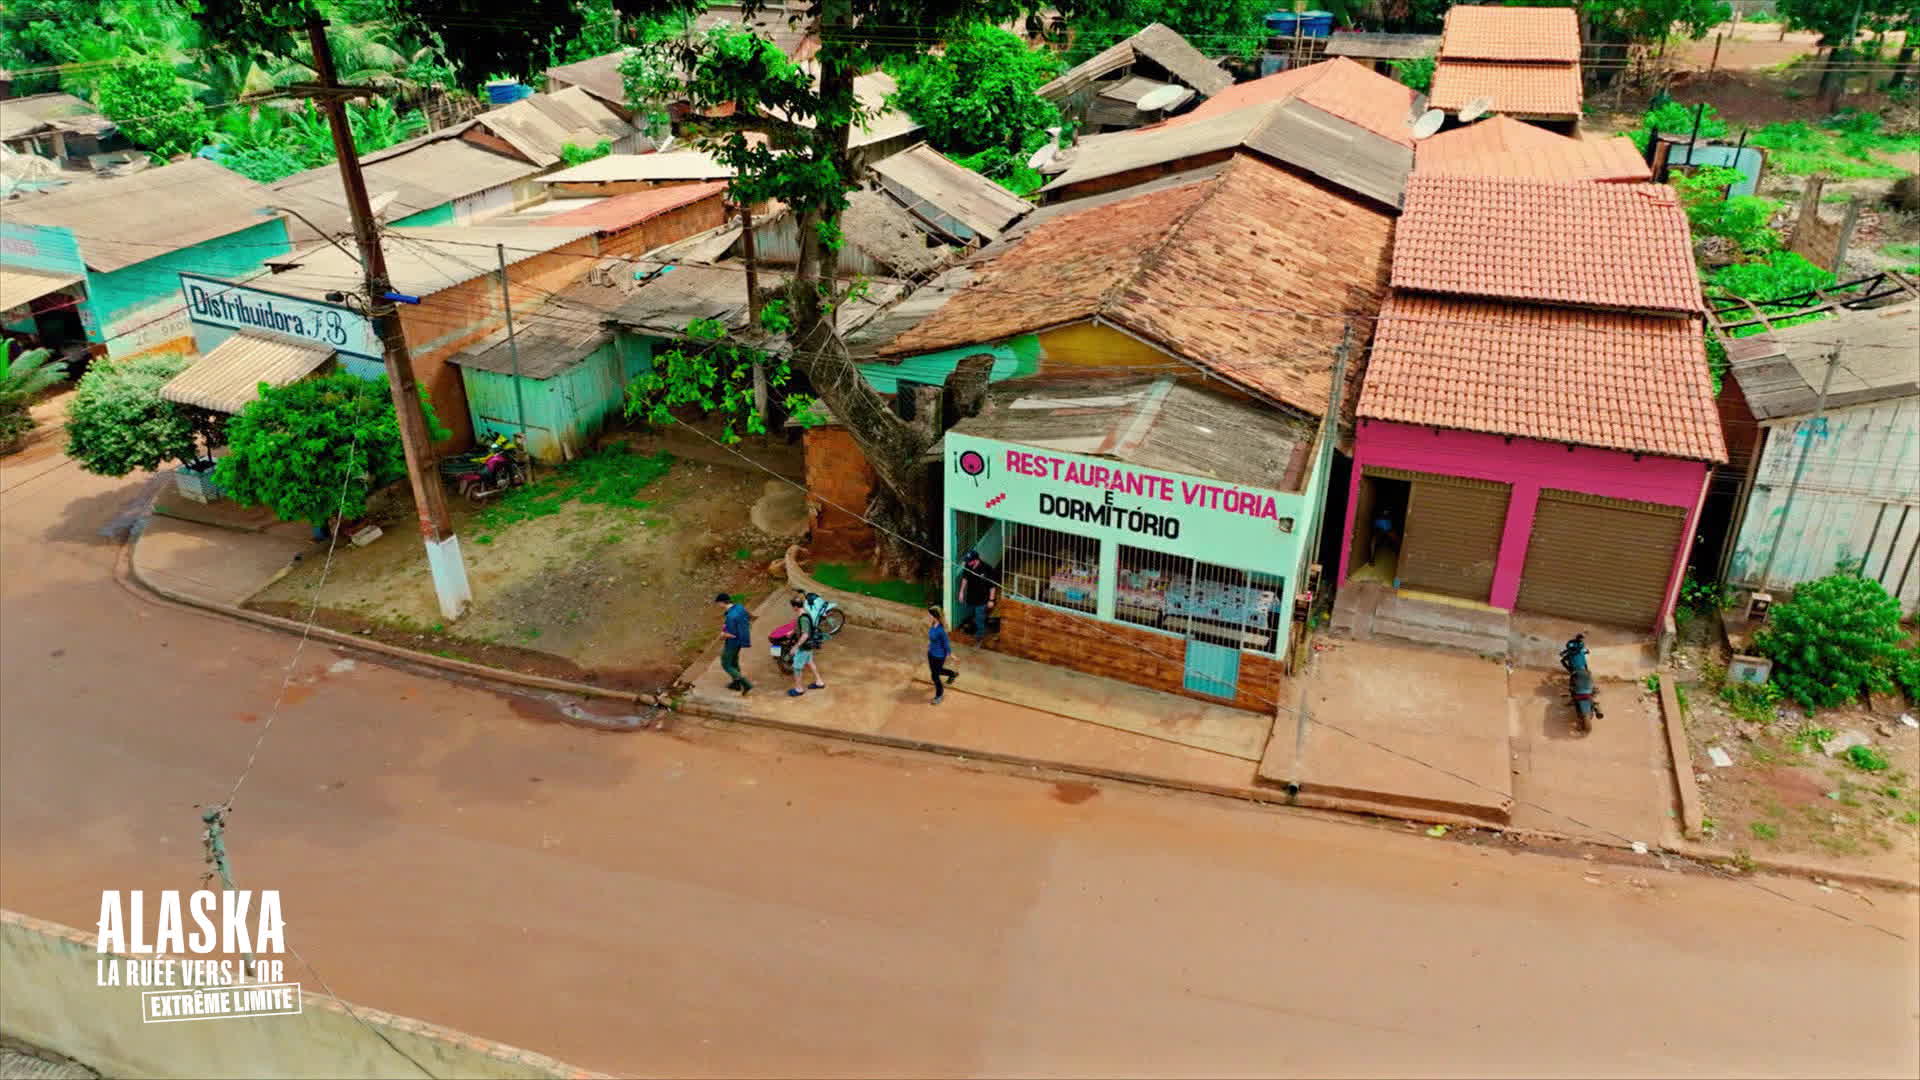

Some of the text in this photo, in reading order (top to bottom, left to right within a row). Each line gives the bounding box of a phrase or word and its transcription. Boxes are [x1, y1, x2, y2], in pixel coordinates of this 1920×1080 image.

[1006, 450, 1279, 521] RESTAURANTE VITÓRIA
[1105, 490, 1114, 506] E
[1039, 493, 1180, 540] DORMITÓRIO
